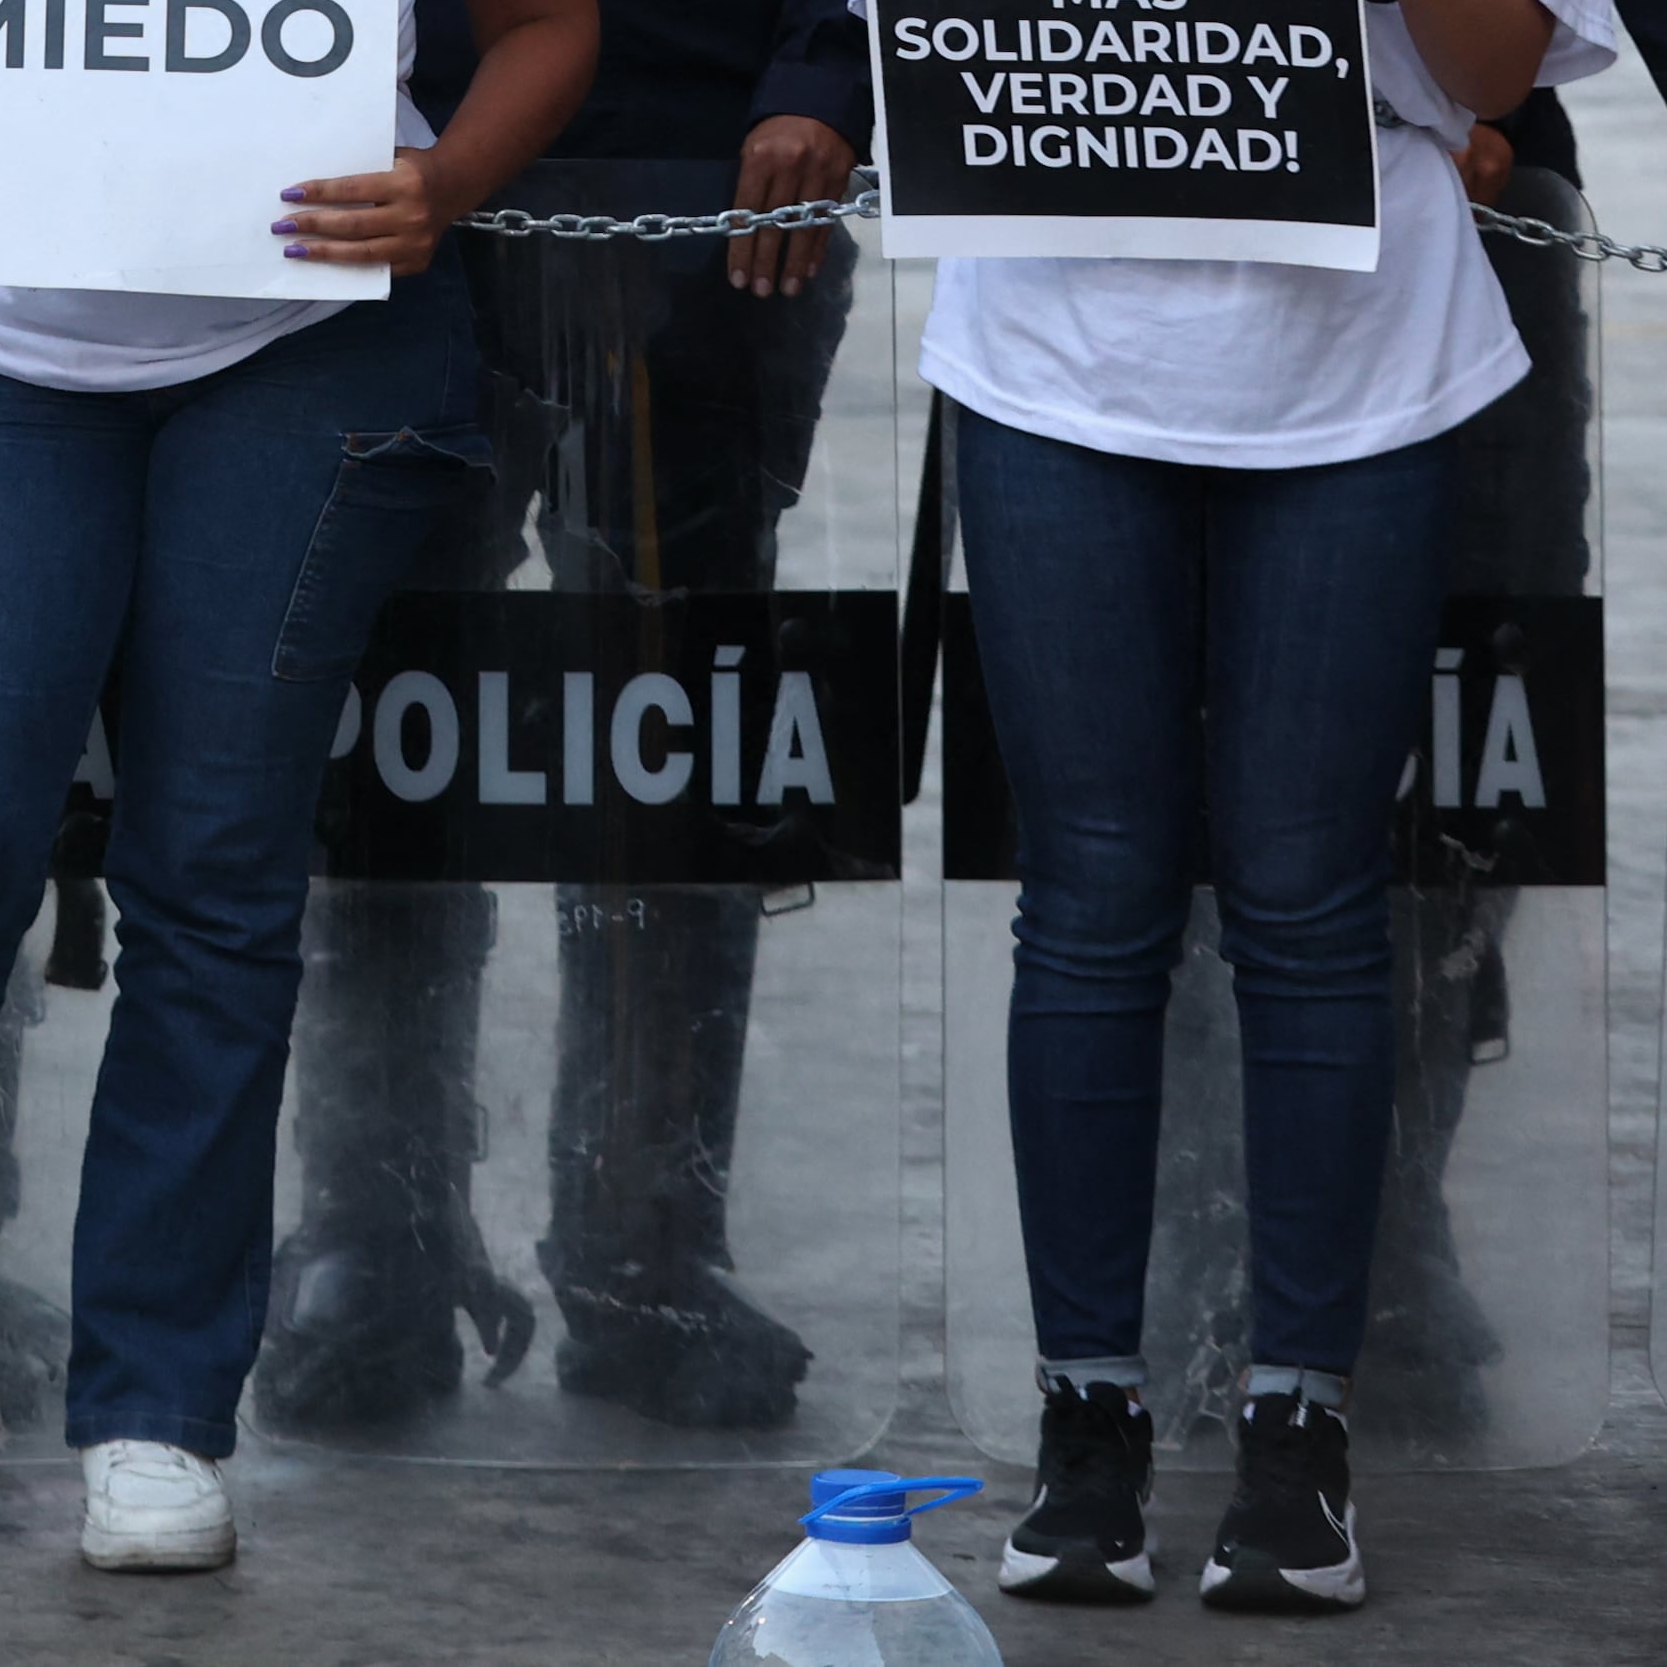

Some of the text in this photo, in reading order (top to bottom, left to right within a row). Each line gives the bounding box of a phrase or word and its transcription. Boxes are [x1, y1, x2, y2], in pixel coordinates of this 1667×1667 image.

[895, 17, 1350, 80] SOLIDARIDAD,
[961, 72, 1290, 119] VERDAD Y
[962, 124, 1301, 173] DIGNIDAD!
